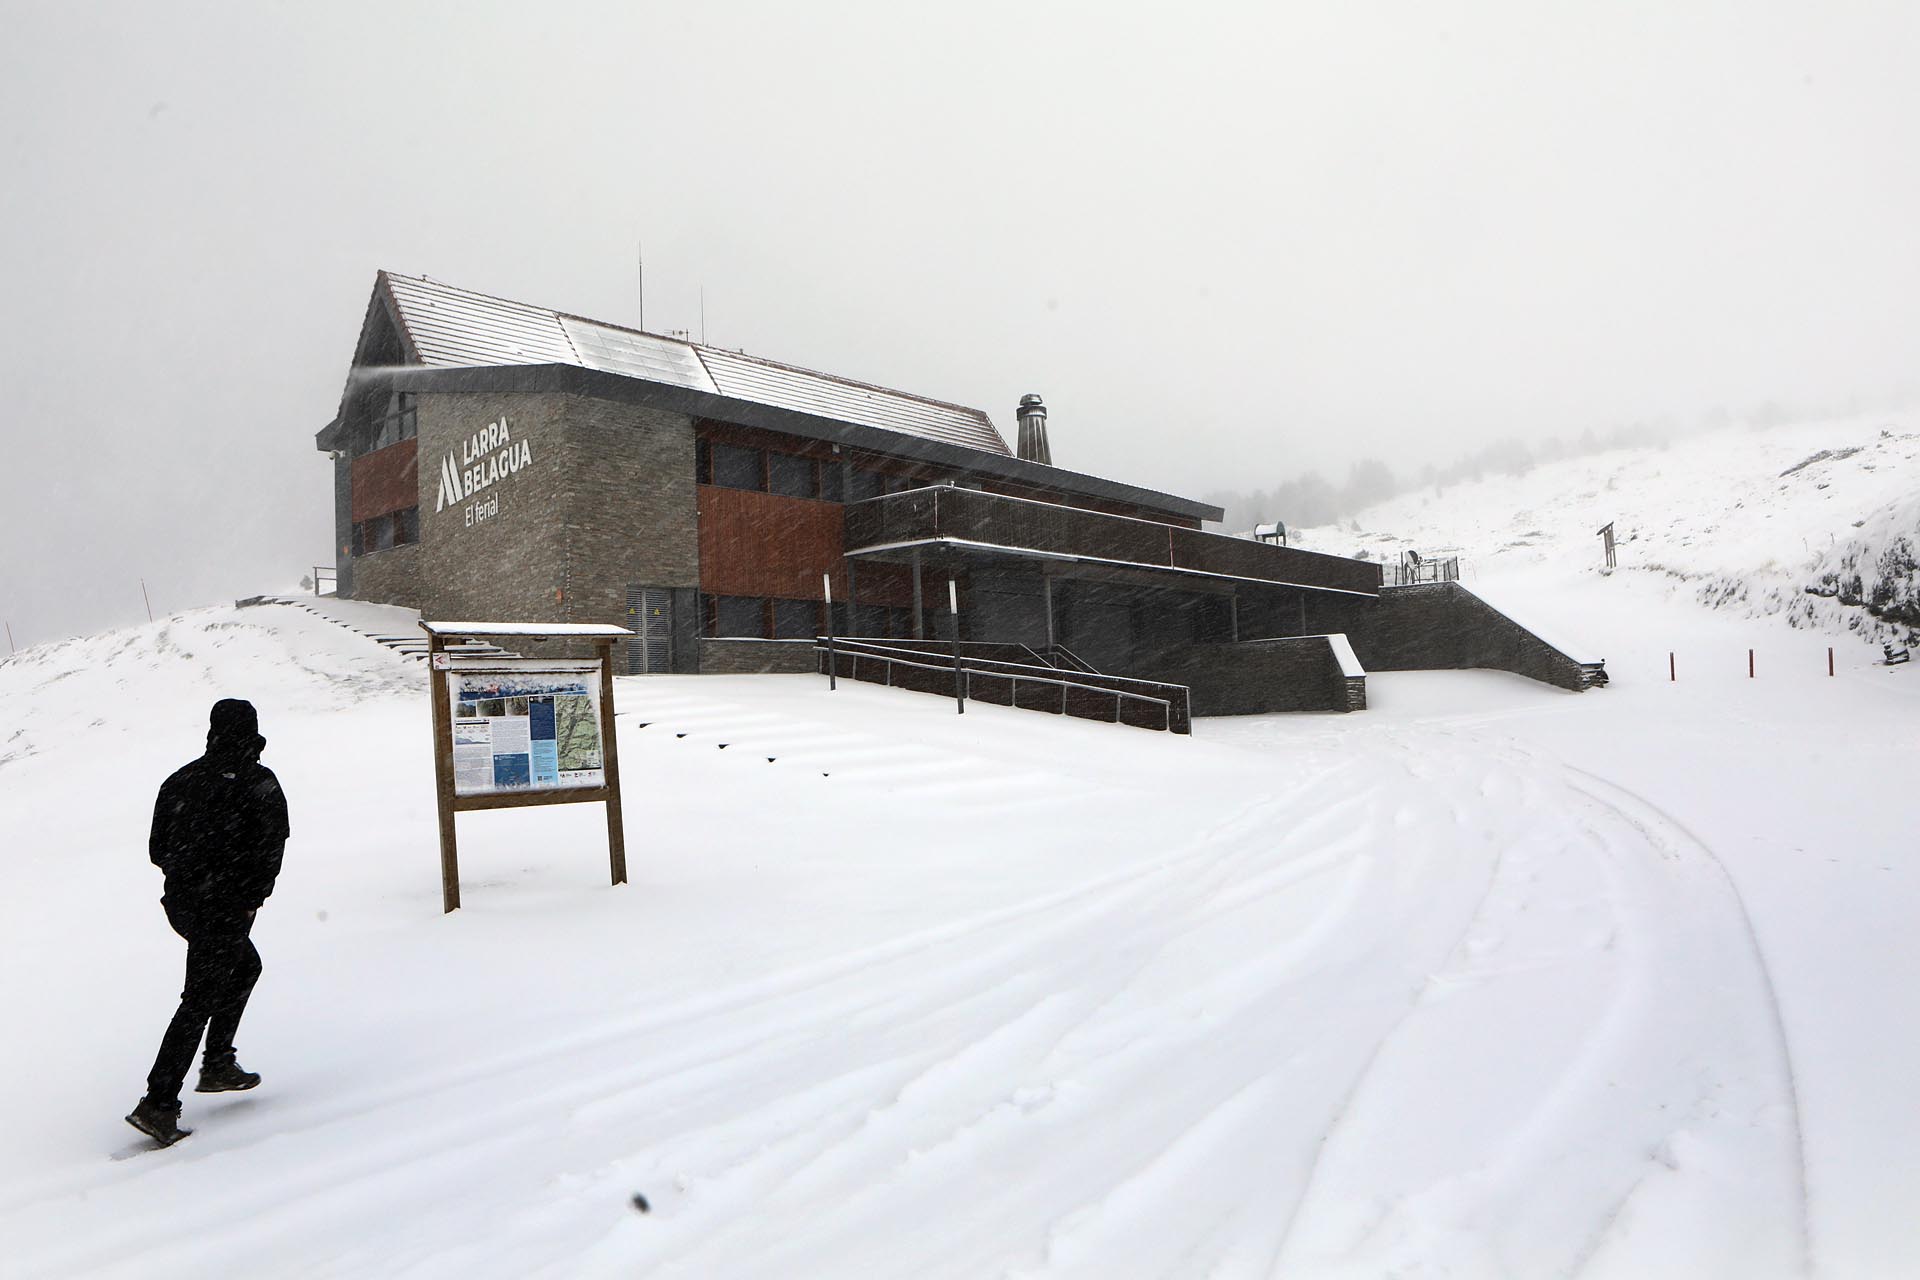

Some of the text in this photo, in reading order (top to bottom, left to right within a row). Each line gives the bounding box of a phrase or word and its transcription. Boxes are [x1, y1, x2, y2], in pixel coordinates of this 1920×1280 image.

[463, 416, 510, 466] LARRA
[464, 439, 532, 497] BELAGUA
[465, 492, 499, 528] El ferial
